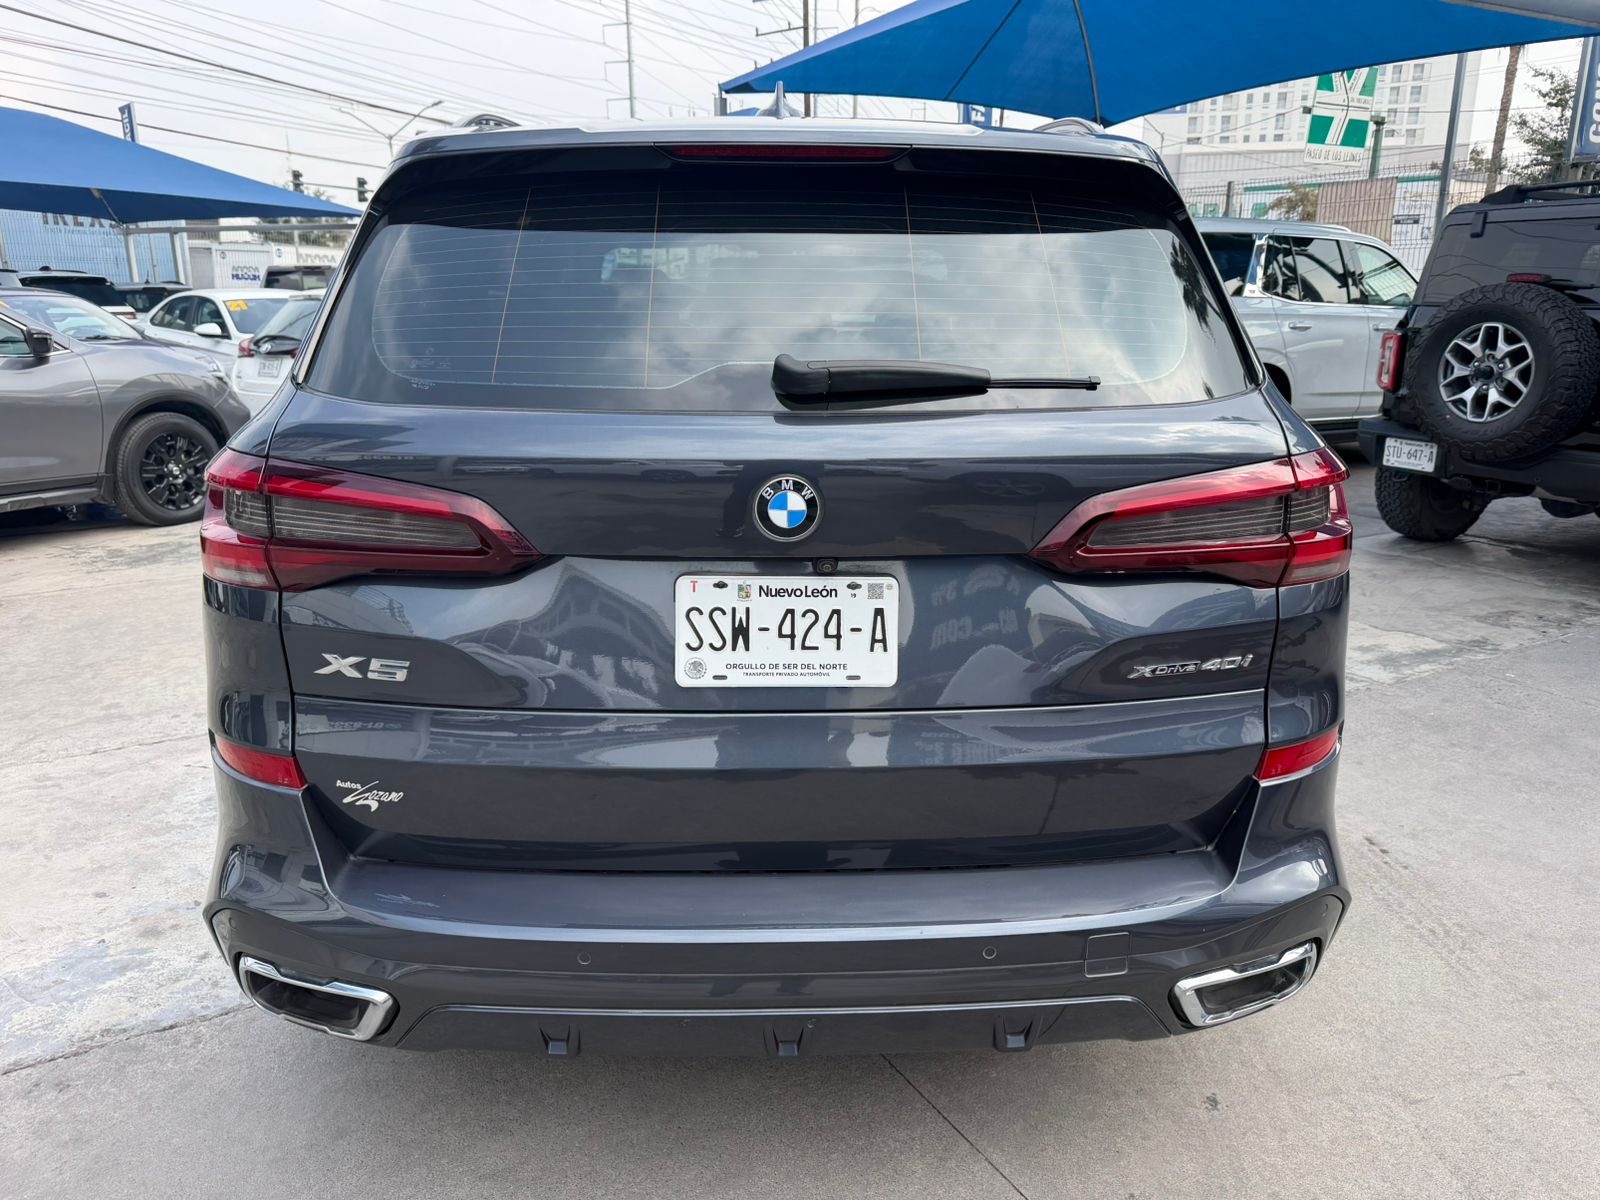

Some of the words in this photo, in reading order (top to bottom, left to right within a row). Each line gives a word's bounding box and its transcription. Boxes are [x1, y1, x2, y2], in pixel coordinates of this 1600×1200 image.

[1323, 149, 1331, 160] DE
[1332, 150, 1341, 161] LOS
[1386, 445, 1434, 464] STU-647-A
[761, 479, 814, 500] BMW
[690, 580, 698, 593] T
[758, 585, 803, 598] Nuevo
[804, 585, 838, 598] León
[685, 606, 888, 653] SSW-424-A
[313, 652, 411, 682] X5
[819, 663, 848, 671] NORTE
[336, 779, 362, 789] Autos
